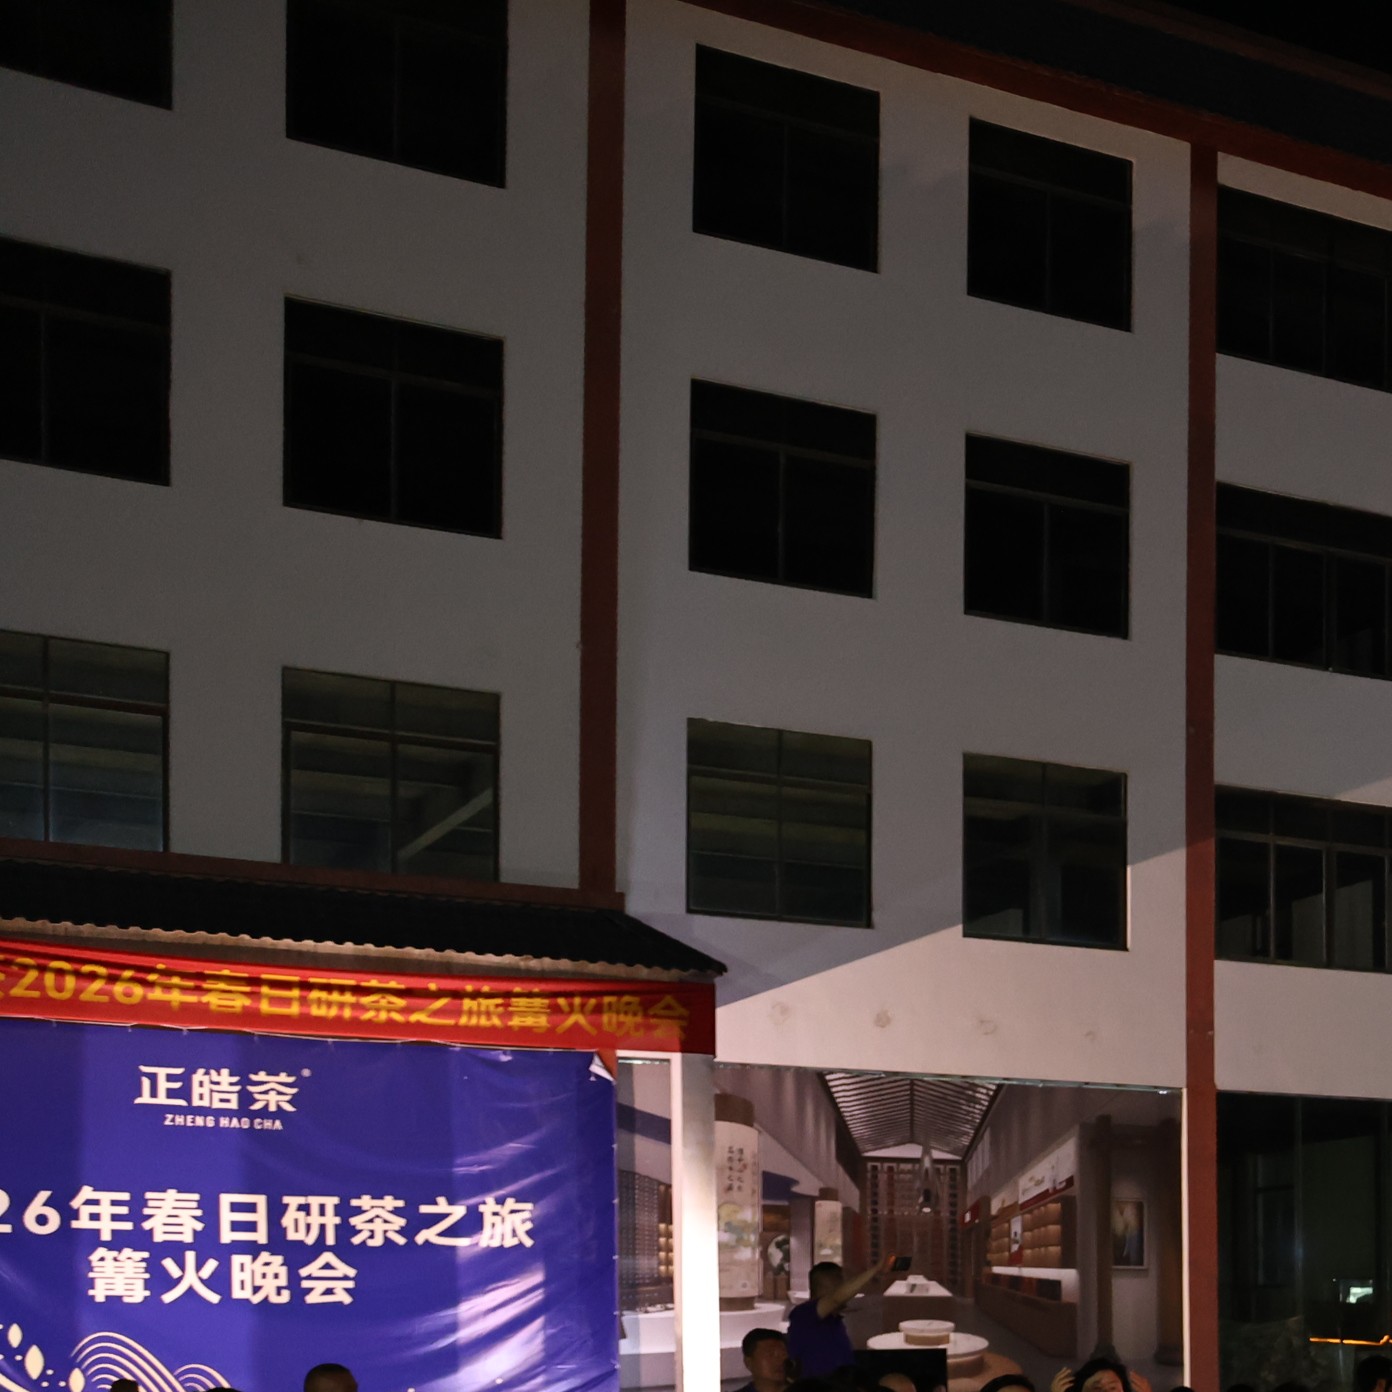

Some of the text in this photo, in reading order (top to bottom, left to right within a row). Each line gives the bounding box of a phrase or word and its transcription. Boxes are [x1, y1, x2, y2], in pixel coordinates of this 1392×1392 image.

[0, 956, 690, 1040] 2026年春日研茶之旅篝火晚会
[133, 1064, 300, 1113] 正皓茶
[163, 1113, 284, 1131] ZHENG HAO CHA
[87, 1246, 359, 1306] 篝火晚会
